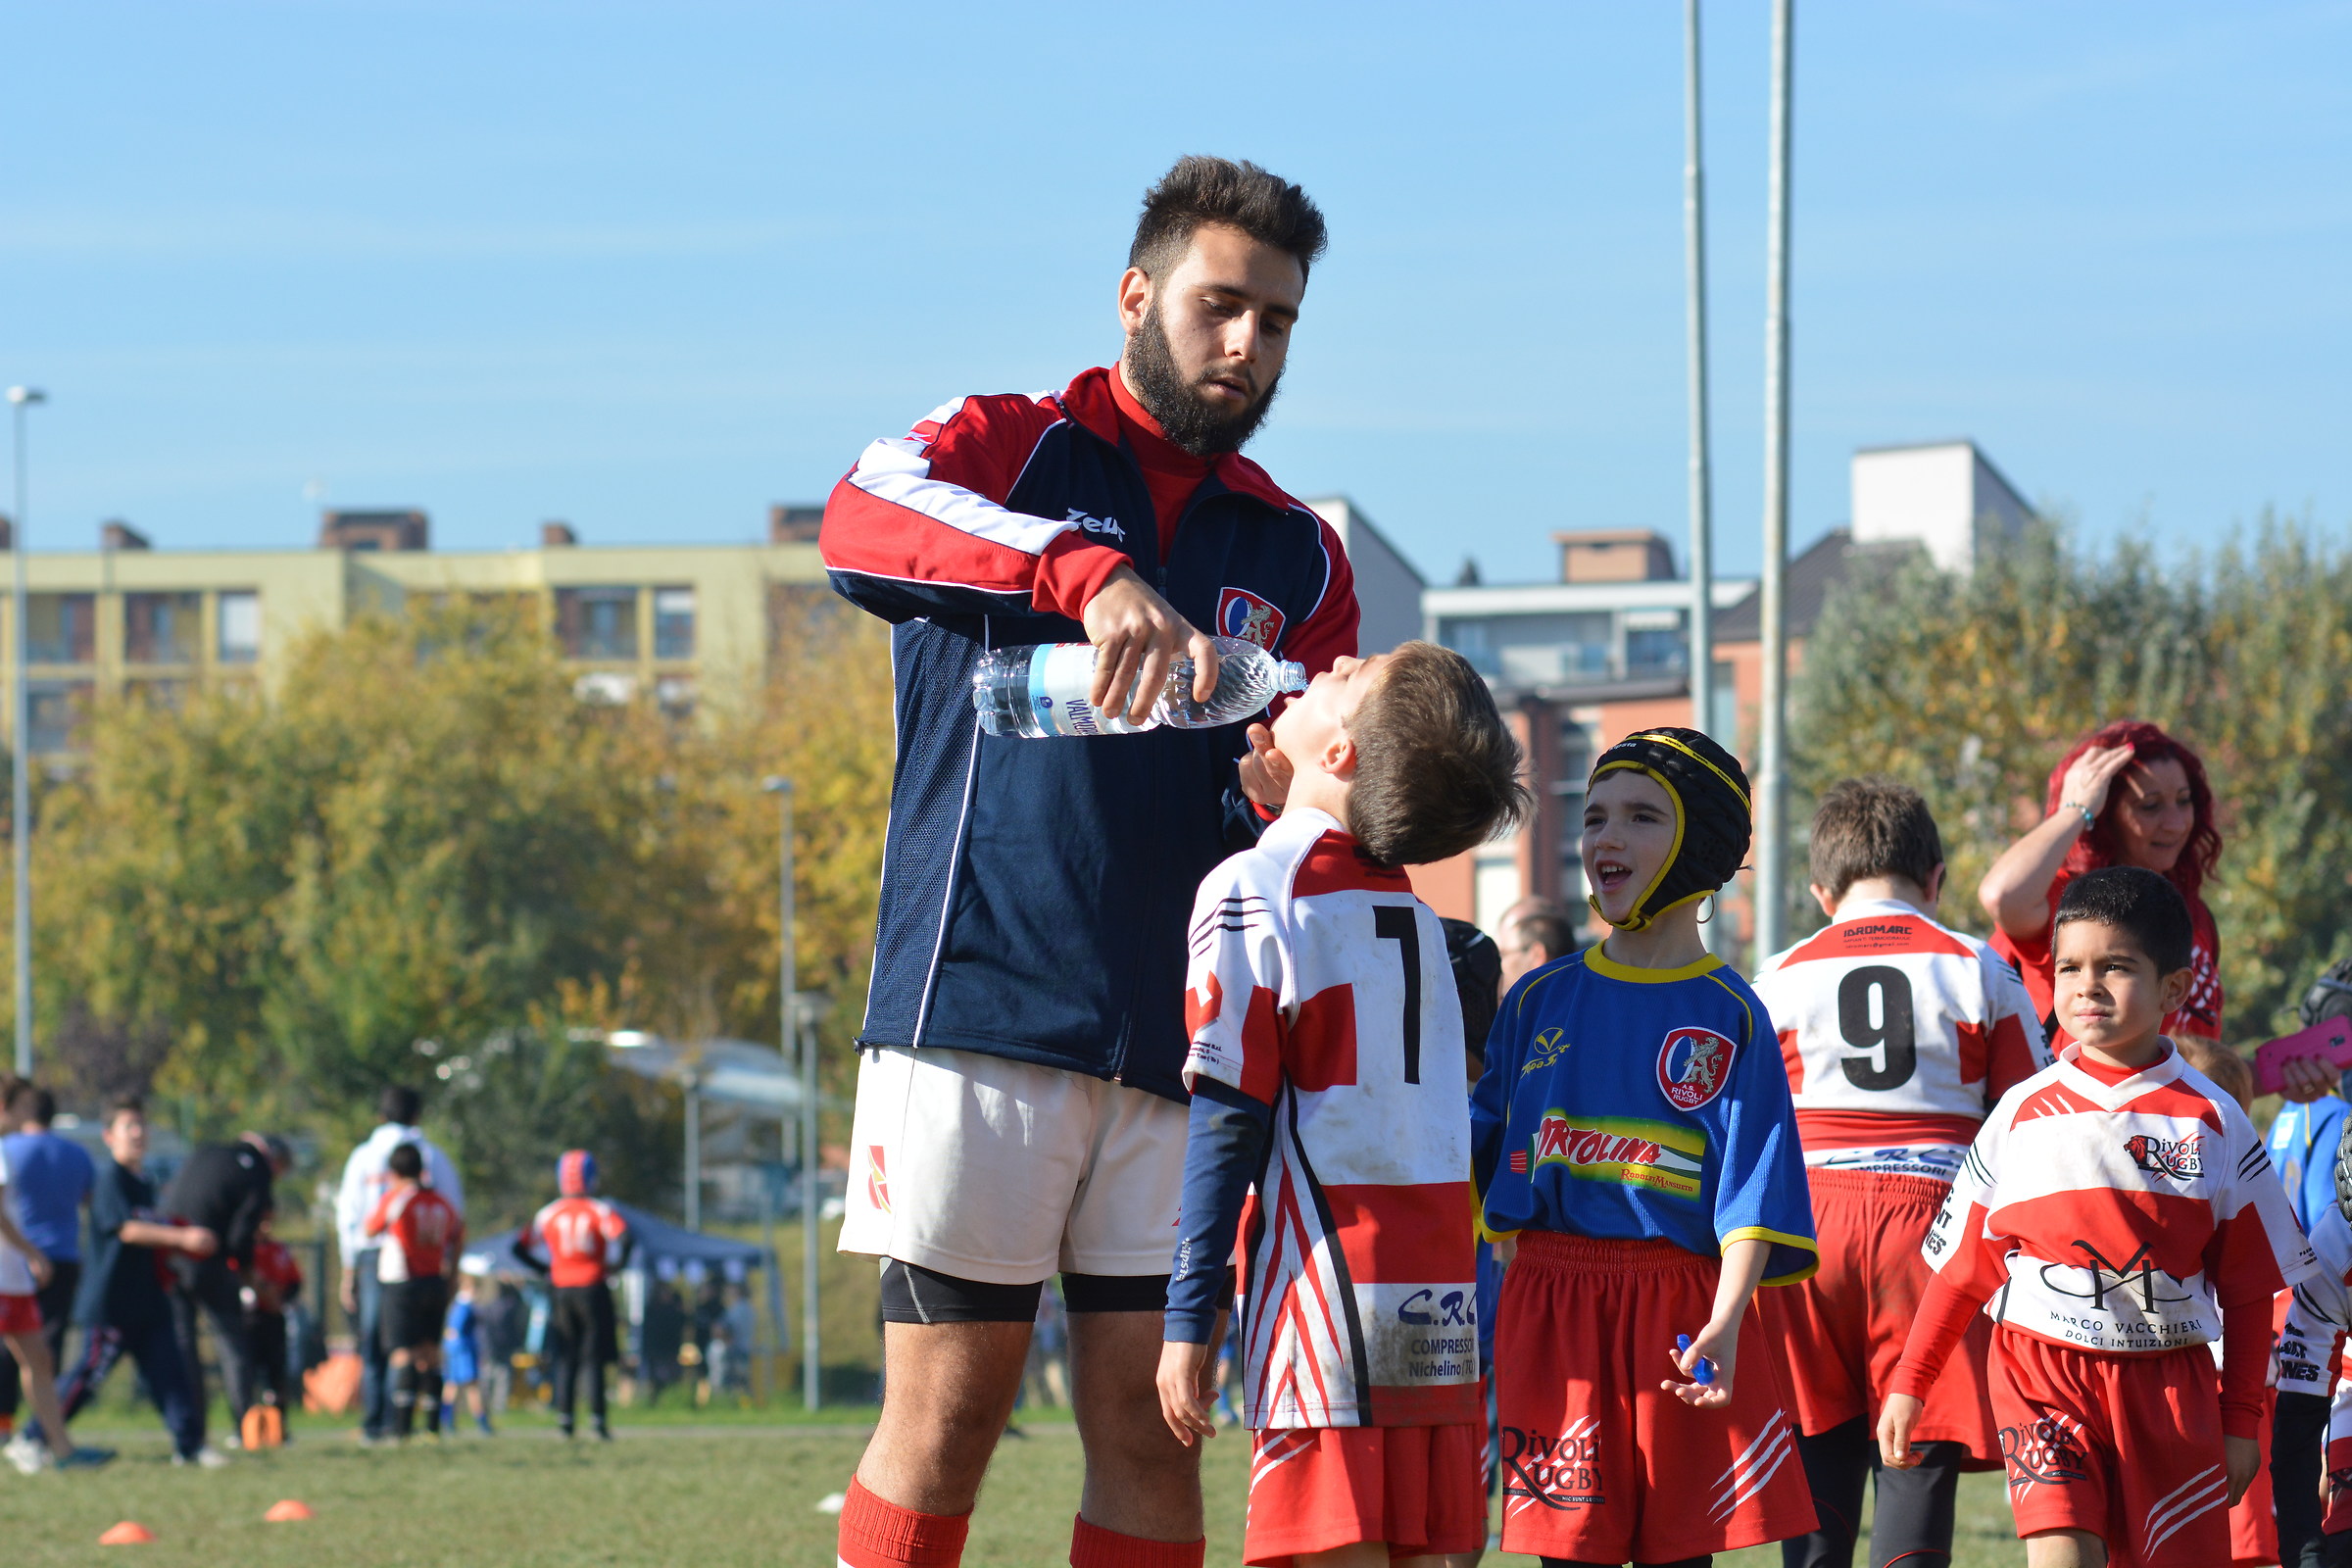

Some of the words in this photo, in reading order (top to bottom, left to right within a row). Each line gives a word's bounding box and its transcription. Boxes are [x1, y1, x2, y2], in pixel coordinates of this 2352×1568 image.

[1843, 925, 1913, 938] IDROMARC
[1838, 964, 1916, 1092] 9
[1671, 1087, 1703, 1101] RIVOLI
[1673, 1094, 1699, 1105] RUGBY
[2050, 1310, 2104, 1332] MARCO
[2115, 1318, 2203, 1335] VACCHIERI
[2065, 1329, 2104, 1347] DOLCI
[2111, 1337, 2188, 1348] INTUIZIONI
[1408, 1359, 1461, 1378] Nichelino
